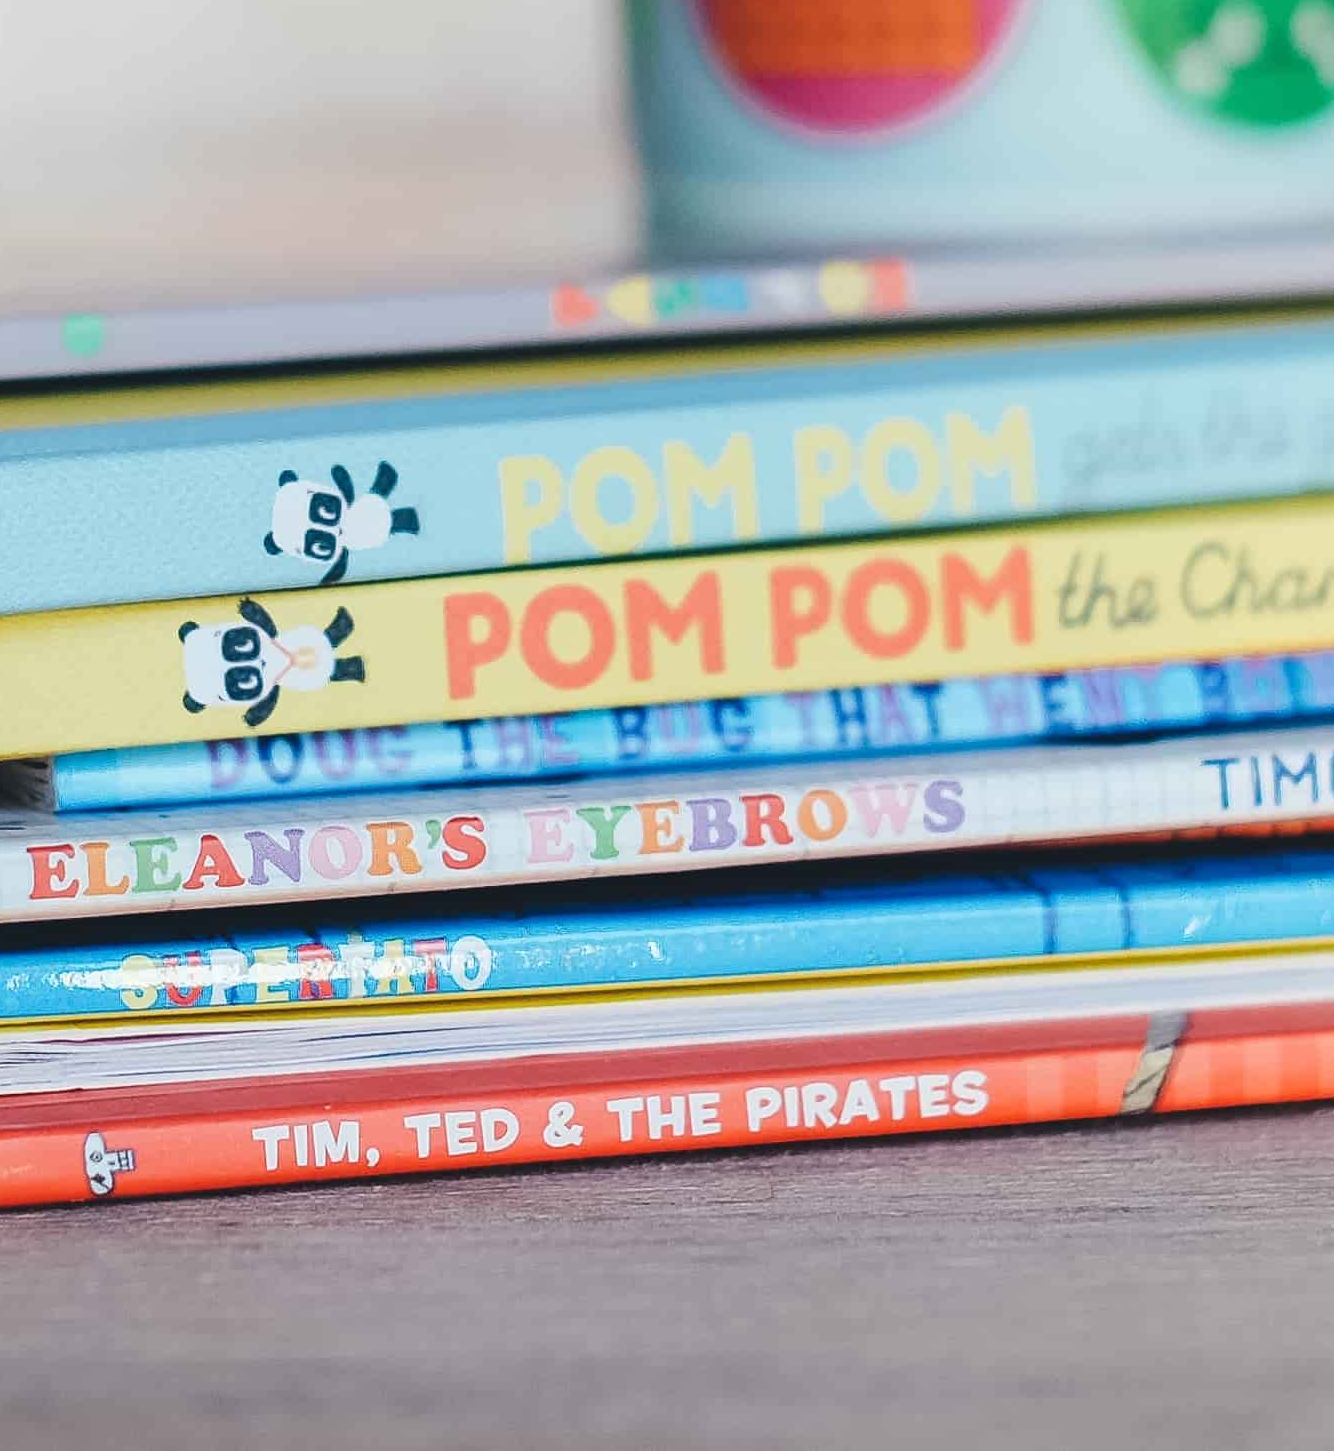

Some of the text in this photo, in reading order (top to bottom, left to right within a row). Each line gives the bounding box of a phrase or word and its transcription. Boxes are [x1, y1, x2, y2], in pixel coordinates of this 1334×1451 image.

[498, 431, 757, 565] POM
[794, 405, 1036, 533] POM
[444, 571, 726, 700] POM
[770, 545, 1035, 670] POM
[1054, 550, 1159, 629] the
[207, 721, 412, 790] DOUG
[444, 706, 580, 772] THE
[610, 694, 752, 762] BUG
[785, 682, 944, 751] THAT
[26, 779, 966, 900] ELEANOR'S EYEBROWS
[119, 933, 492, 1010] SUPERTATO
[251, 1069, 988, 1171] TIM, TED & THE PIRATES
